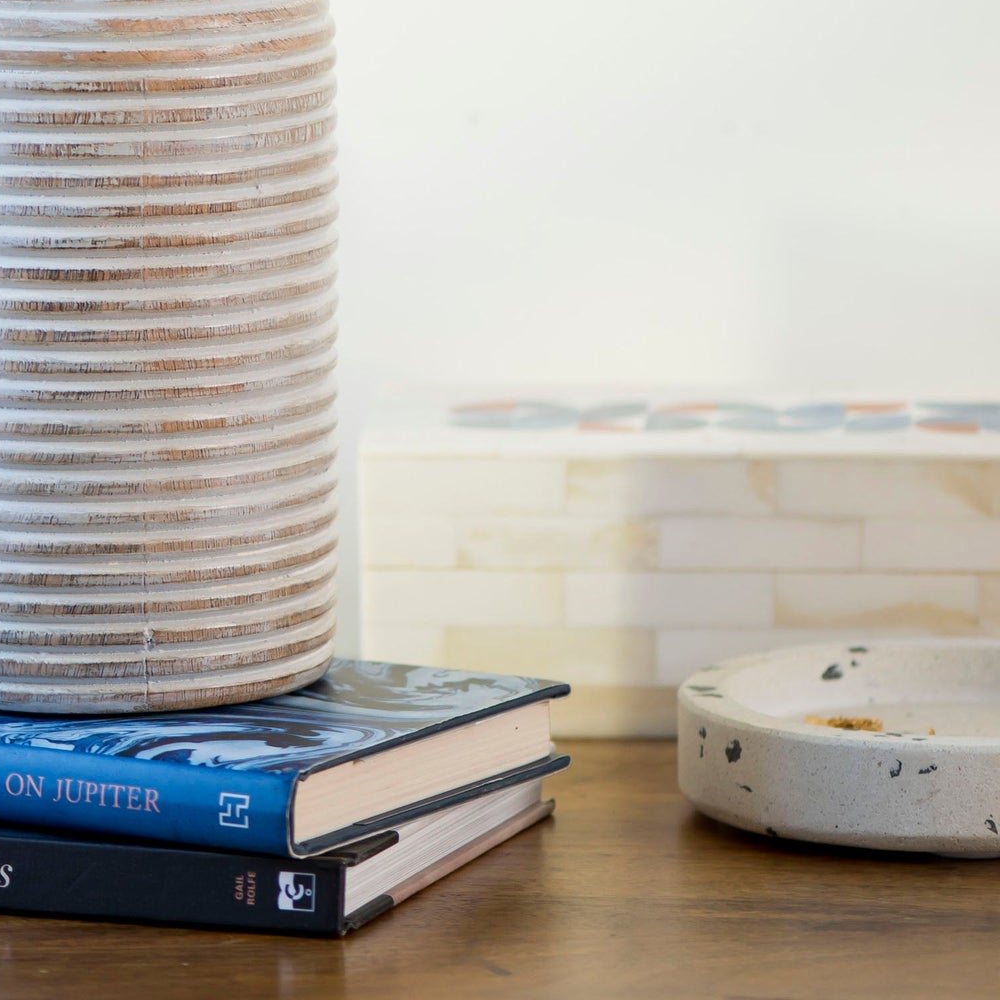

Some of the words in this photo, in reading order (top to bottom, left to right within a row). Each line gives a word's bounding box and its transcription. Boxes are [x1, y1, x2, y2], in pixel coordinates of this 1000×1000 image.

[4, 772, 44, 798] ON
[53, 778, 162, 814] JUPITER
[234, 875, 245, 901] GAIL
[246, 871, 257, 906] ROLFE
